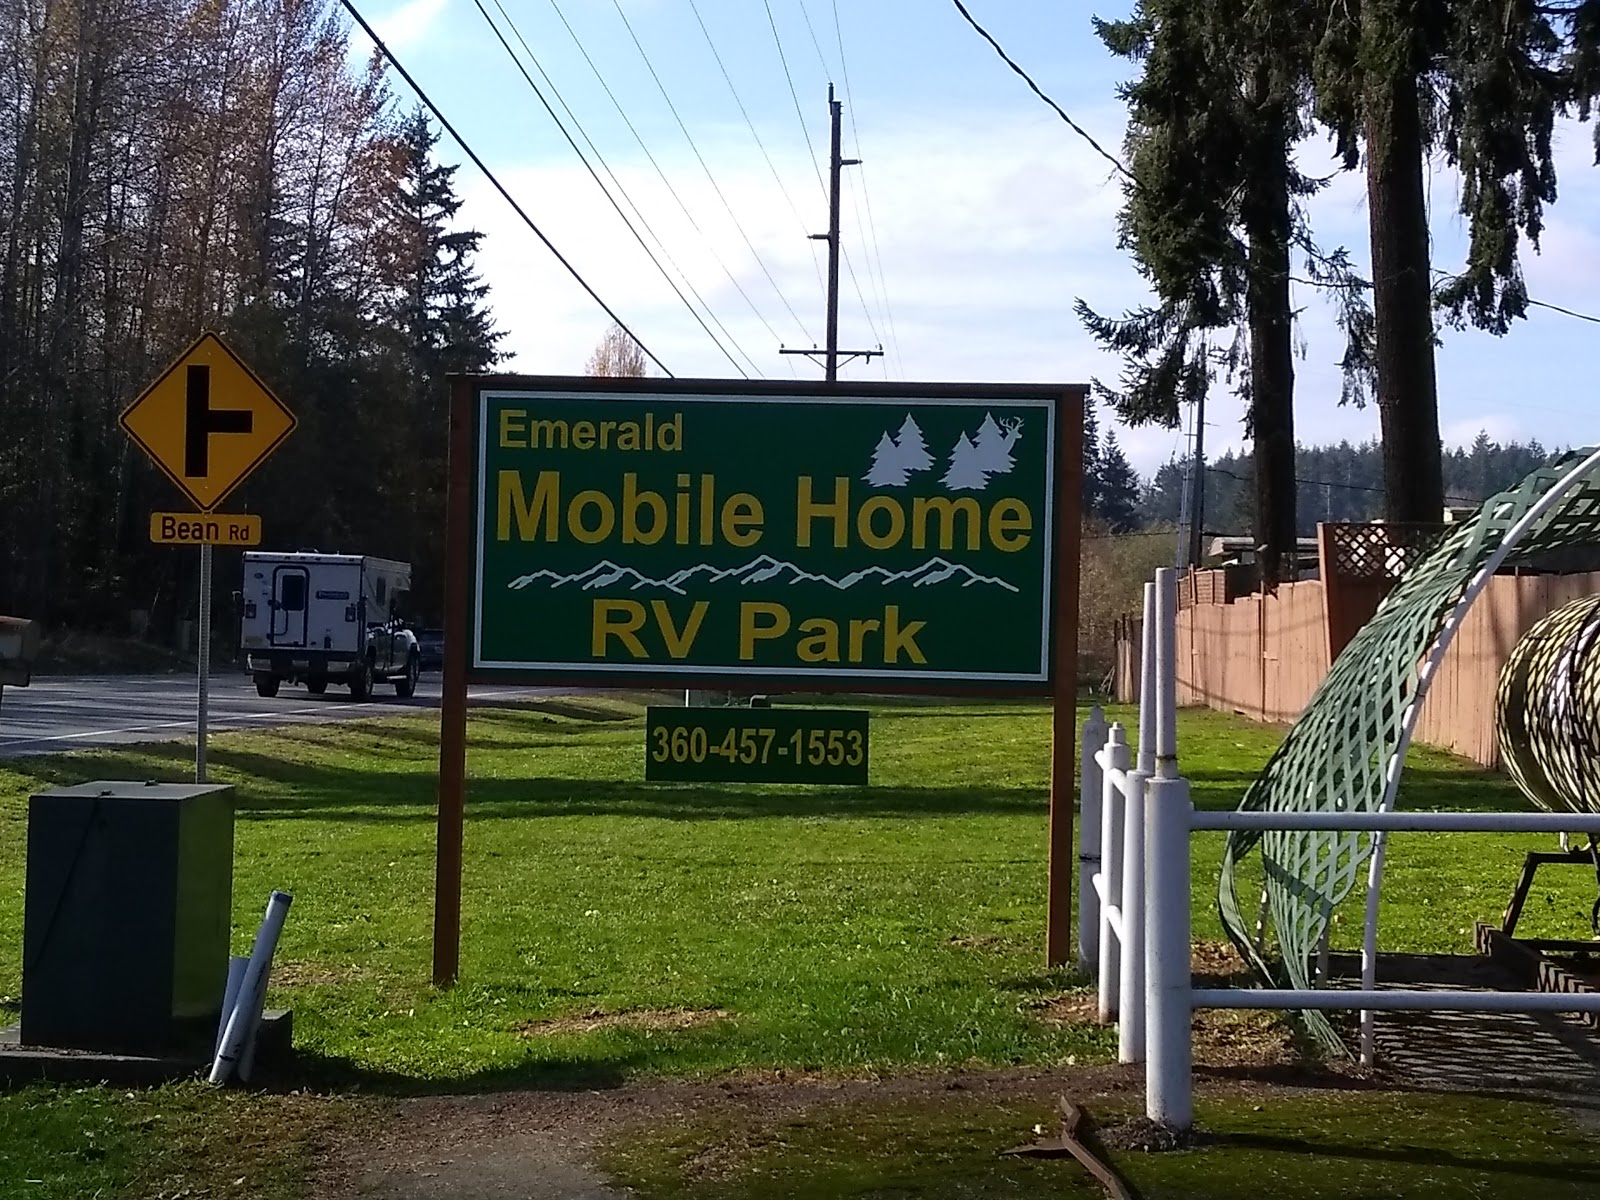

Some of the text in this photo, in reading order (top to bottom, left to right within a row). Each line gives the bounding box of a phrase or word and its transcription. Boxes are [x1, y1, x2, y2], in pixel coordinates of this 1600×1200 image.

[499, 409, 683, 452] Emerald
[162, 516, 249, 541] Bean Rd
[497, 470, 1033, 553] Mobile Home
[591, 599, 928, 665] RV Park
[652, 726, 863, 766] 360-457-1553
